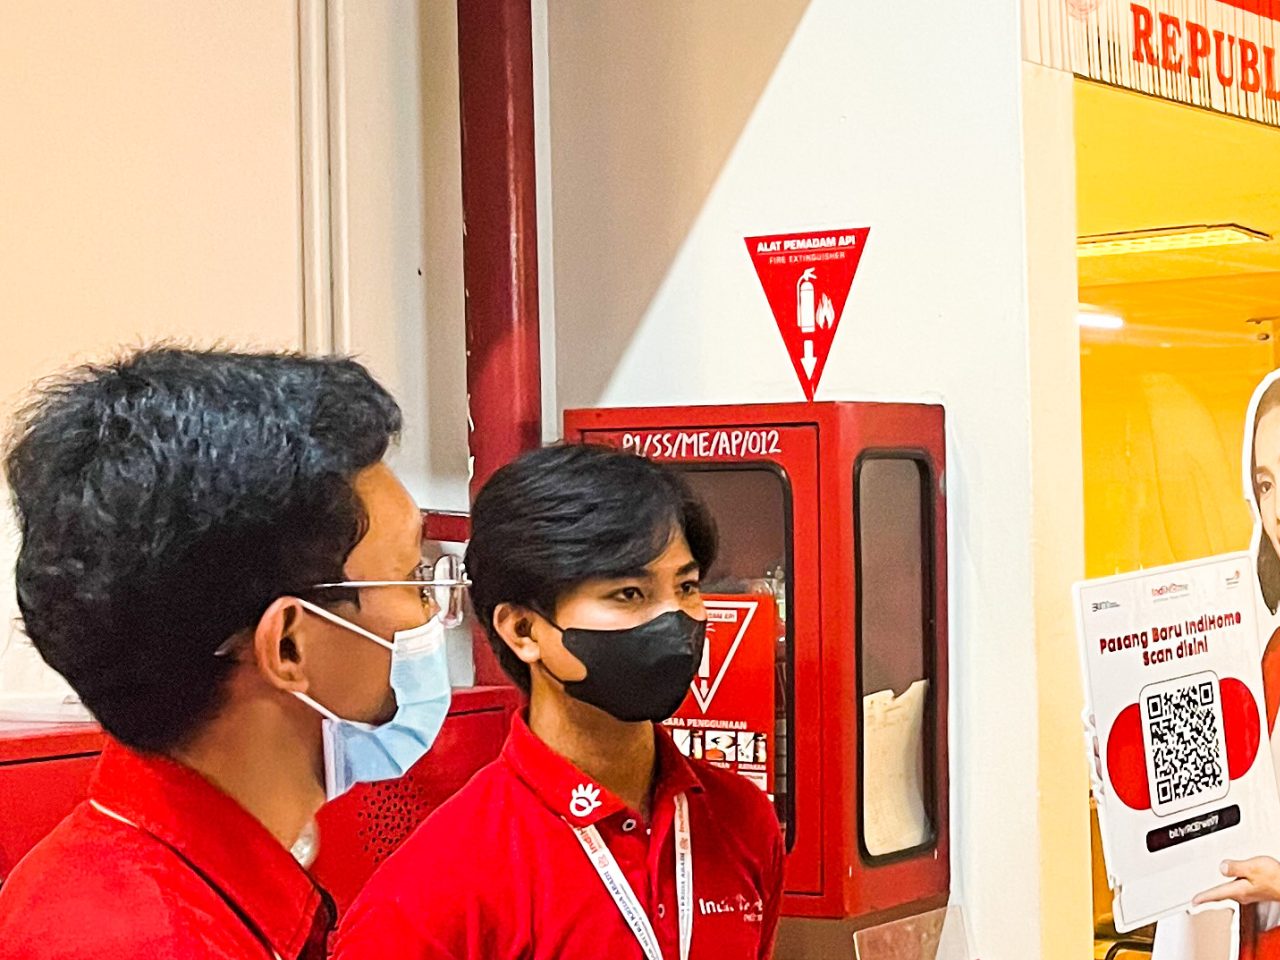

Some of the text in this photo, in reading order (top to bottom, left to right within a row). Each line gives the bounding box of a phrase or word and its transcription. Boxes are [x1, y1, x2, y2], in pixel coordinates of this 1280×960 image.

[757, 234, 856, 253] ALAT PEMADAM API
[769, 251, 845, 264] FIRE EXTINGUISHER
[1100, 611, 1241, 654] Pasang Baru IndiHome
[1143, 635, 1208, 666] Scan disini
[662, 717, 747, 730] CARA PENGGUNAAN
[577, 826, 598, 854] IndiH
